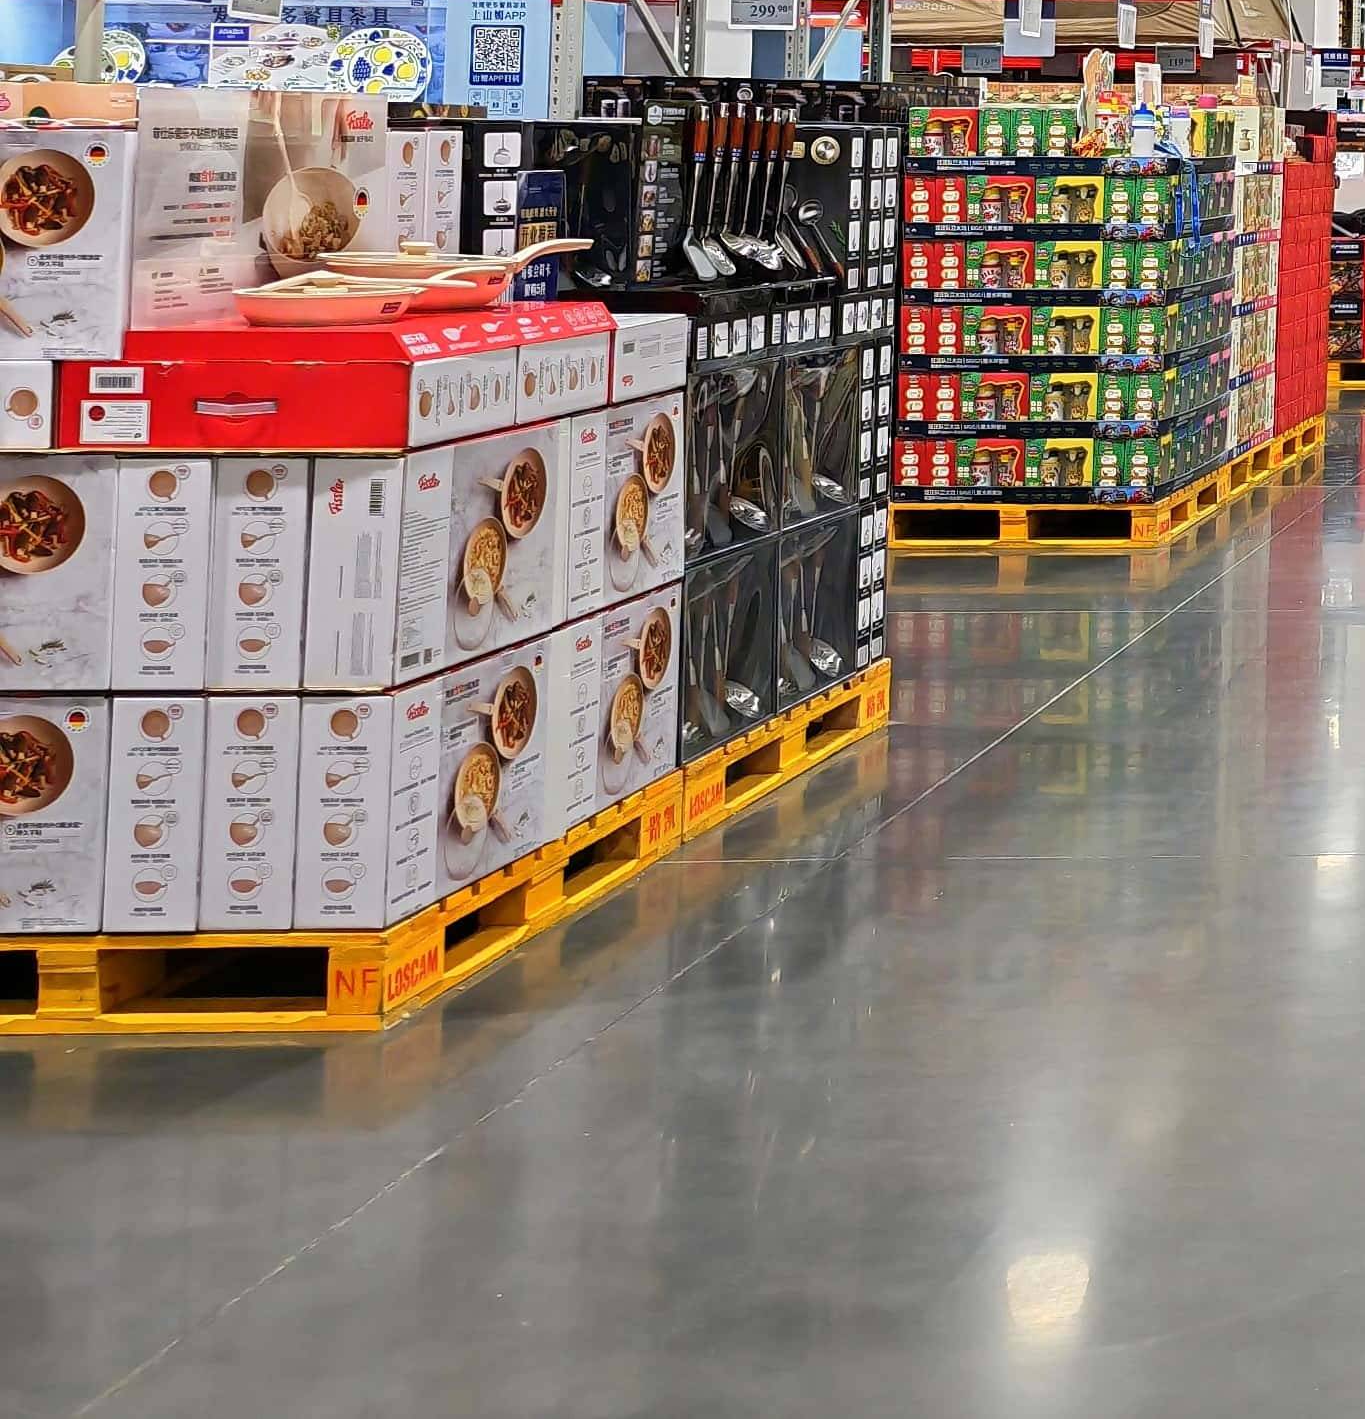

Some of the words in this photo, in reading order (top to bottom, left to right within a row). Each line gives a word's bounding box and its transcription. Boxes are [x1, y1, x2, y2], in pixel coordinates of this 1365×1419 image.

[689, 785, 724, 823] LOSCAM
[336, 966, 379, 998] NF
[387, 945, 439, 1002] LOSCAM
